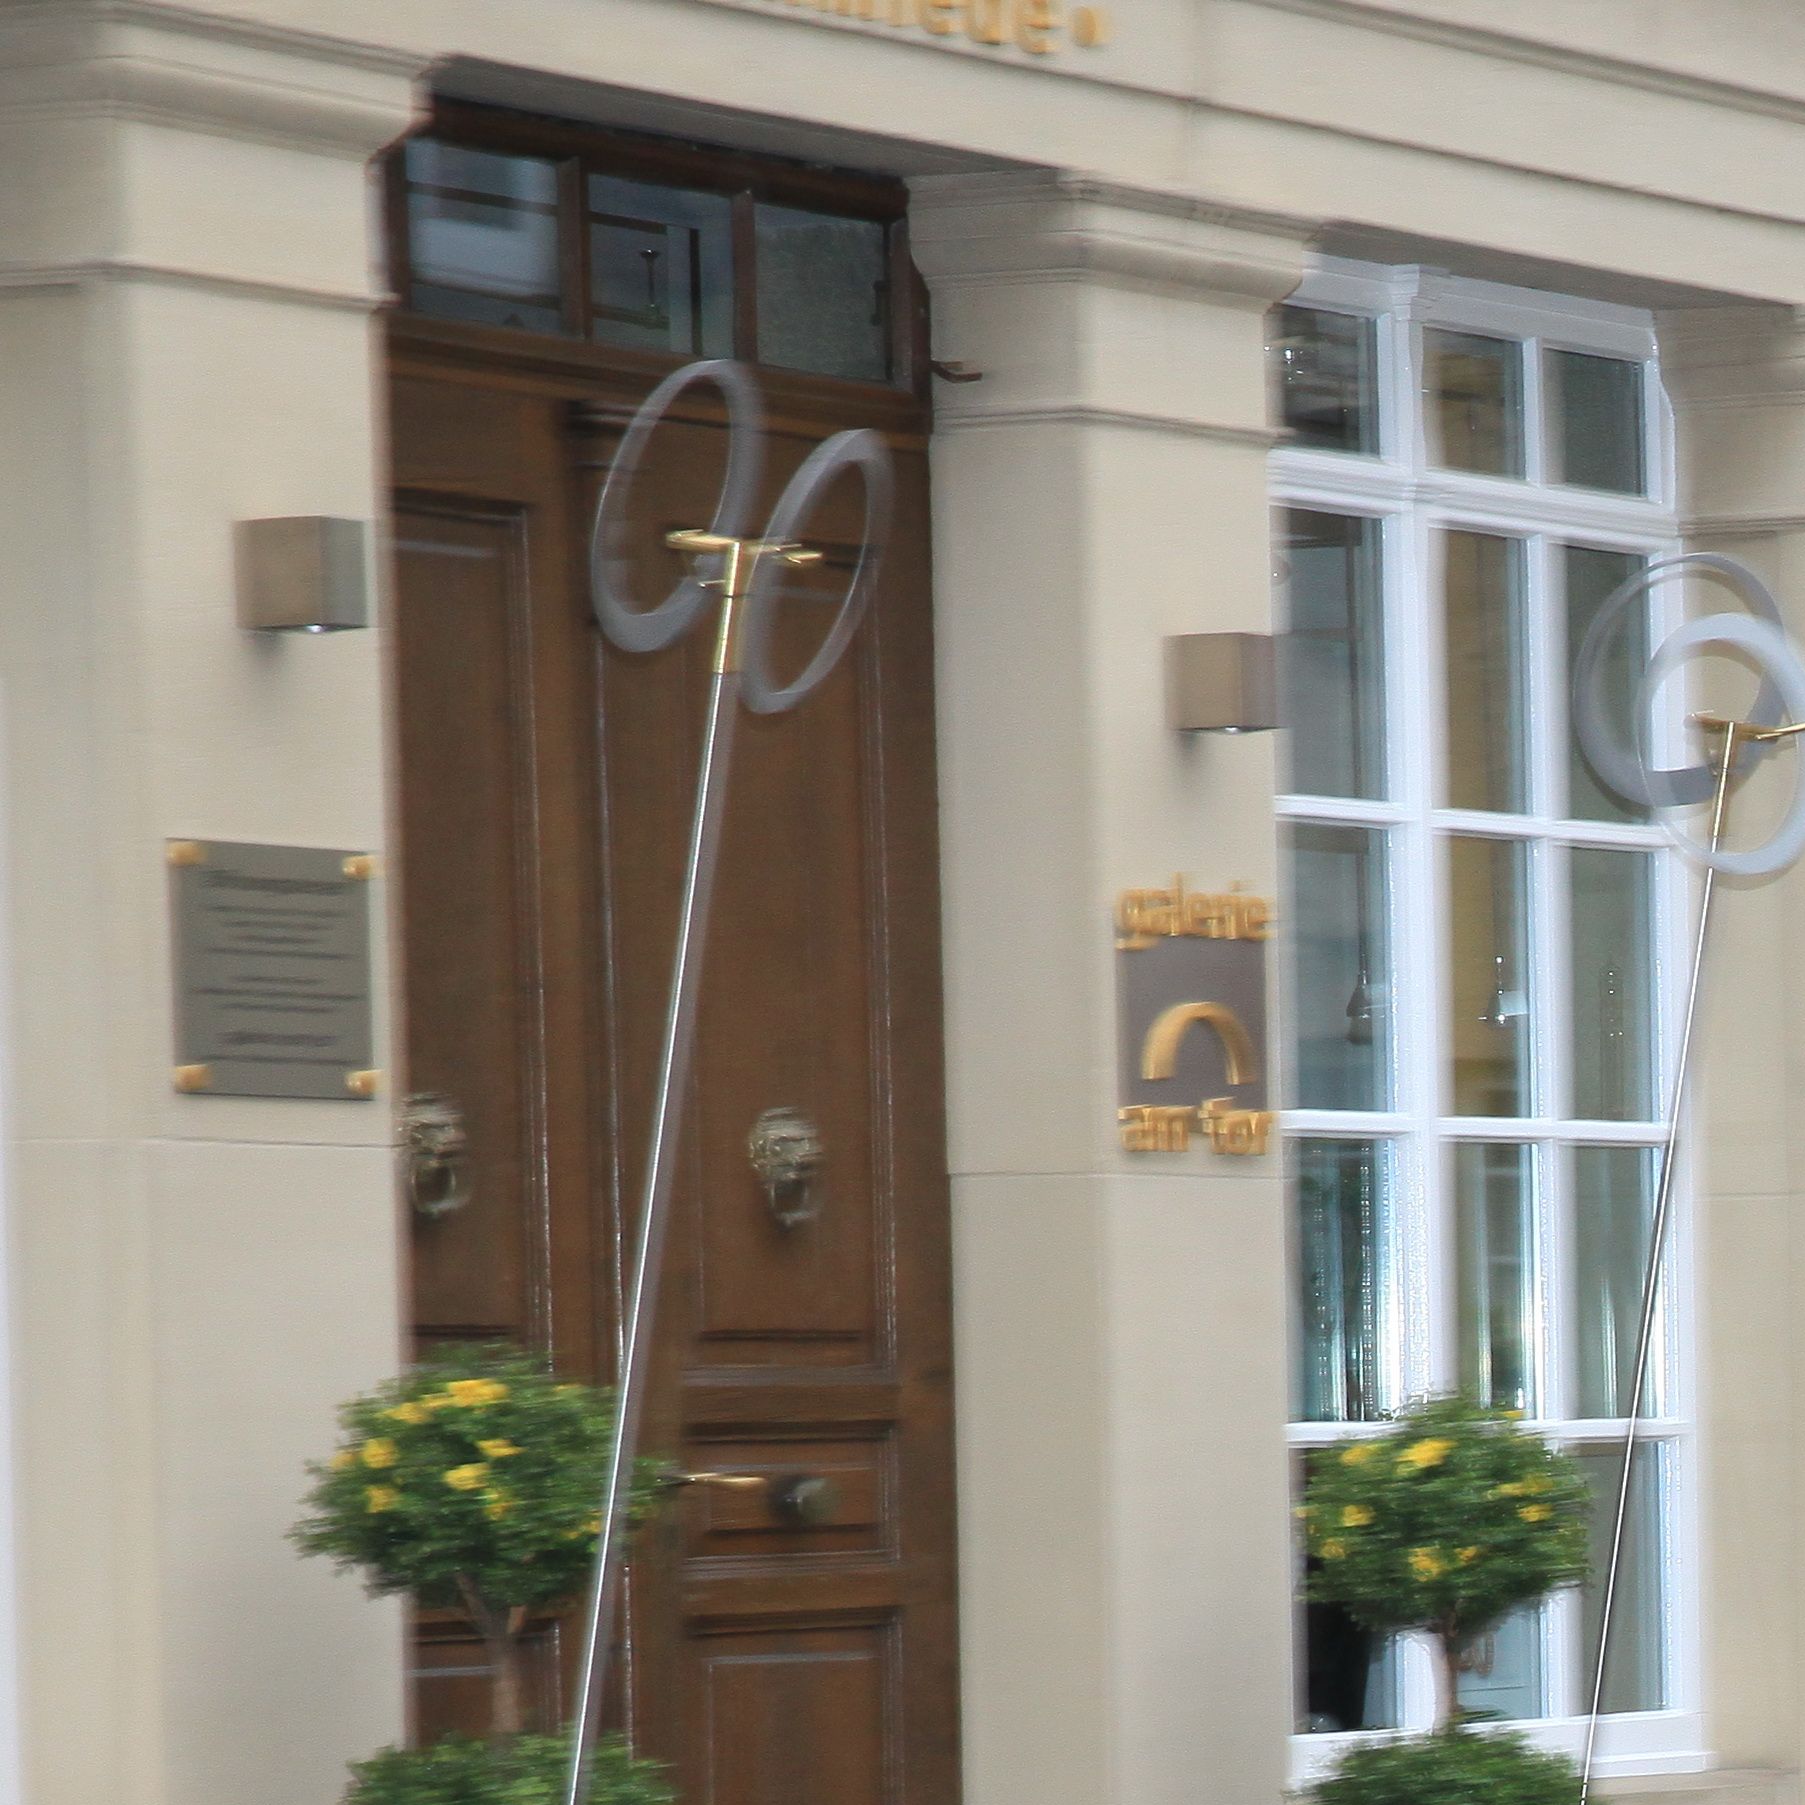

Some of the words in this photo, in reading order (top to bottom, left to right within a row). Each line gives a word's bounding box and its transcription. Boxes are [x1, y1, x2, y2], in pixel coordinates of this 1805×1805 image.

[1117, 872, 1277, 951] galerie
[1118, 1105, 1193, 1153] am
[1198, 1096, 1273, 1156] tor
